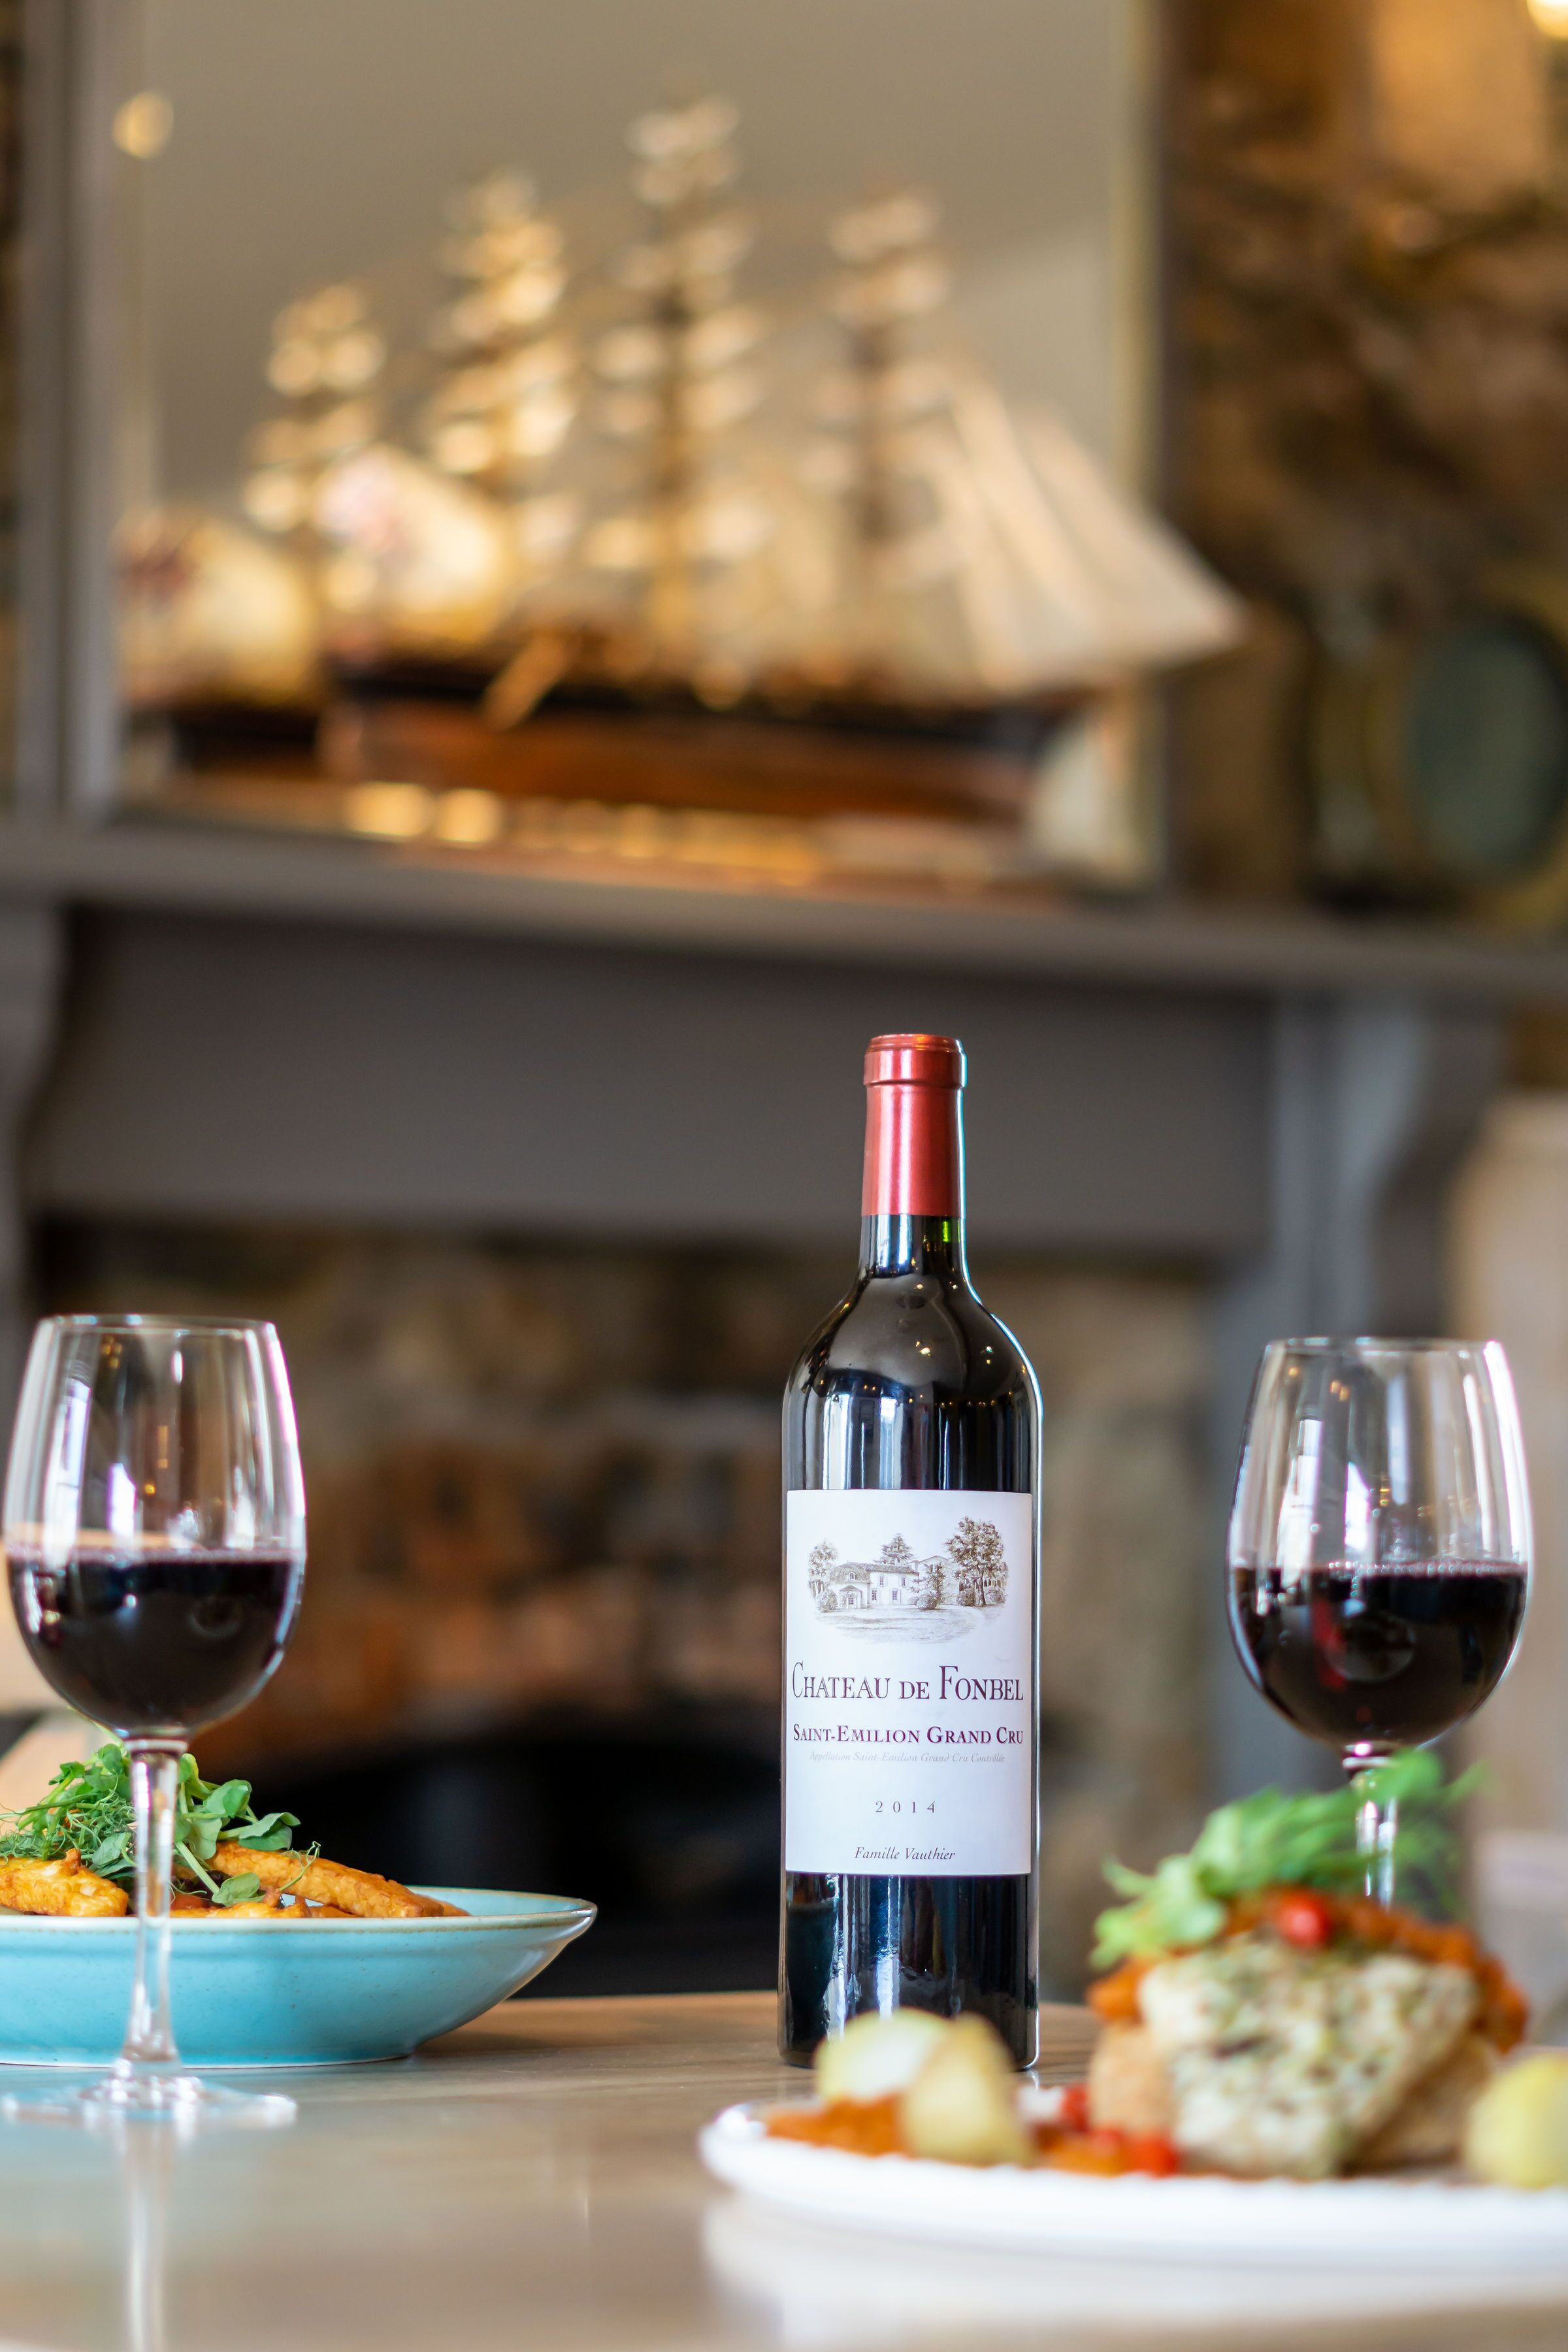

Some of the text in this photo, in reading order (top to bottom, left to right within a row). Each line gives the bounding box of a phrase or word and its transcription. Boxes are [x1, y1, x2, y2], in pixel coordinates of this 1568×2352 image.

[792, 1660, 1024, 1701] CHATEAU DE FONBEL
[793, 1723, 1024, 1744] SAINT-EMILION GRAND CRU
[809, 1750, 851, 1761] Appellation
[921, 1752, 949, 1762] Grand
[952, 1753, 968, 1762] Cru
[854, 1846, 956, 1861] Famille Vauthier
